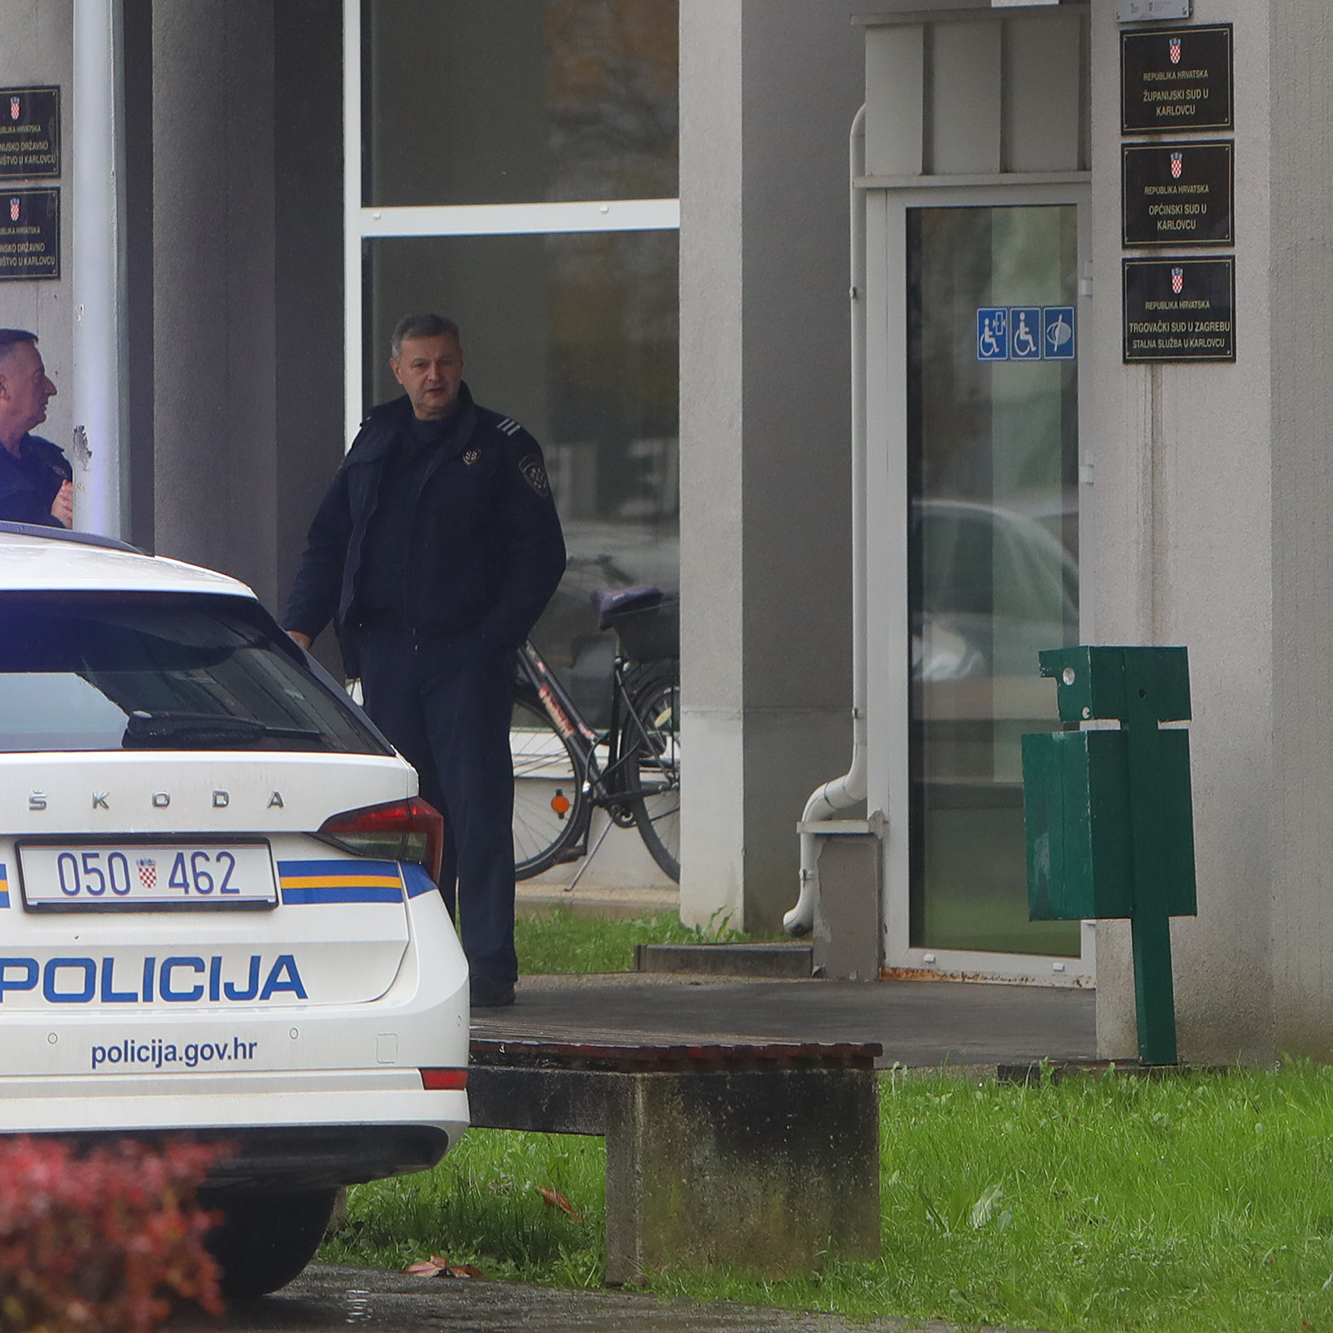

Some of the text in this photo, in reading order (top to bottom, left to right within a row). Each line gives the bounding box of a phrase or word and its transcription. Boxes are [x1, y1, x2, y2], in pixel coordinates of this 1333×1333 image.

[1143, 69, 1209, 82] REPUBLIKA HRVATSKA
[1143, 88, 1209, 102] ŽUPANIJSKI SUD U
[1156, 105, 1196, 116] KARLOVCU
[18, 155, 24, 165] U
[24, 154, 56, 165] KARLOVCU
[1144, 184, 1209, 195] REPUBLIKA HRVATSKA
[1148, 203, 1207, 215] OPĆINSKI SUD U
[1157, 219, 1196, 231] KARLOVCU
[18, 257, 23, 266] U
[23, 255, 55, 266] KARLOVCU
[1145, 300, 1210, 310] REPUBLIKA HRVATSKA
[1129, 320, 1230, 333] TRGOVAČKI SUD U ZAGREBU
[1133, 337, 1225, 349] STALNA SLUŽBA U KARLOVCU
[29, 789, 284, 811] ŠKODA
[57, 850, 240, 896] 050 462
[91, 1038, 258, 1068] policija.gov.hr
